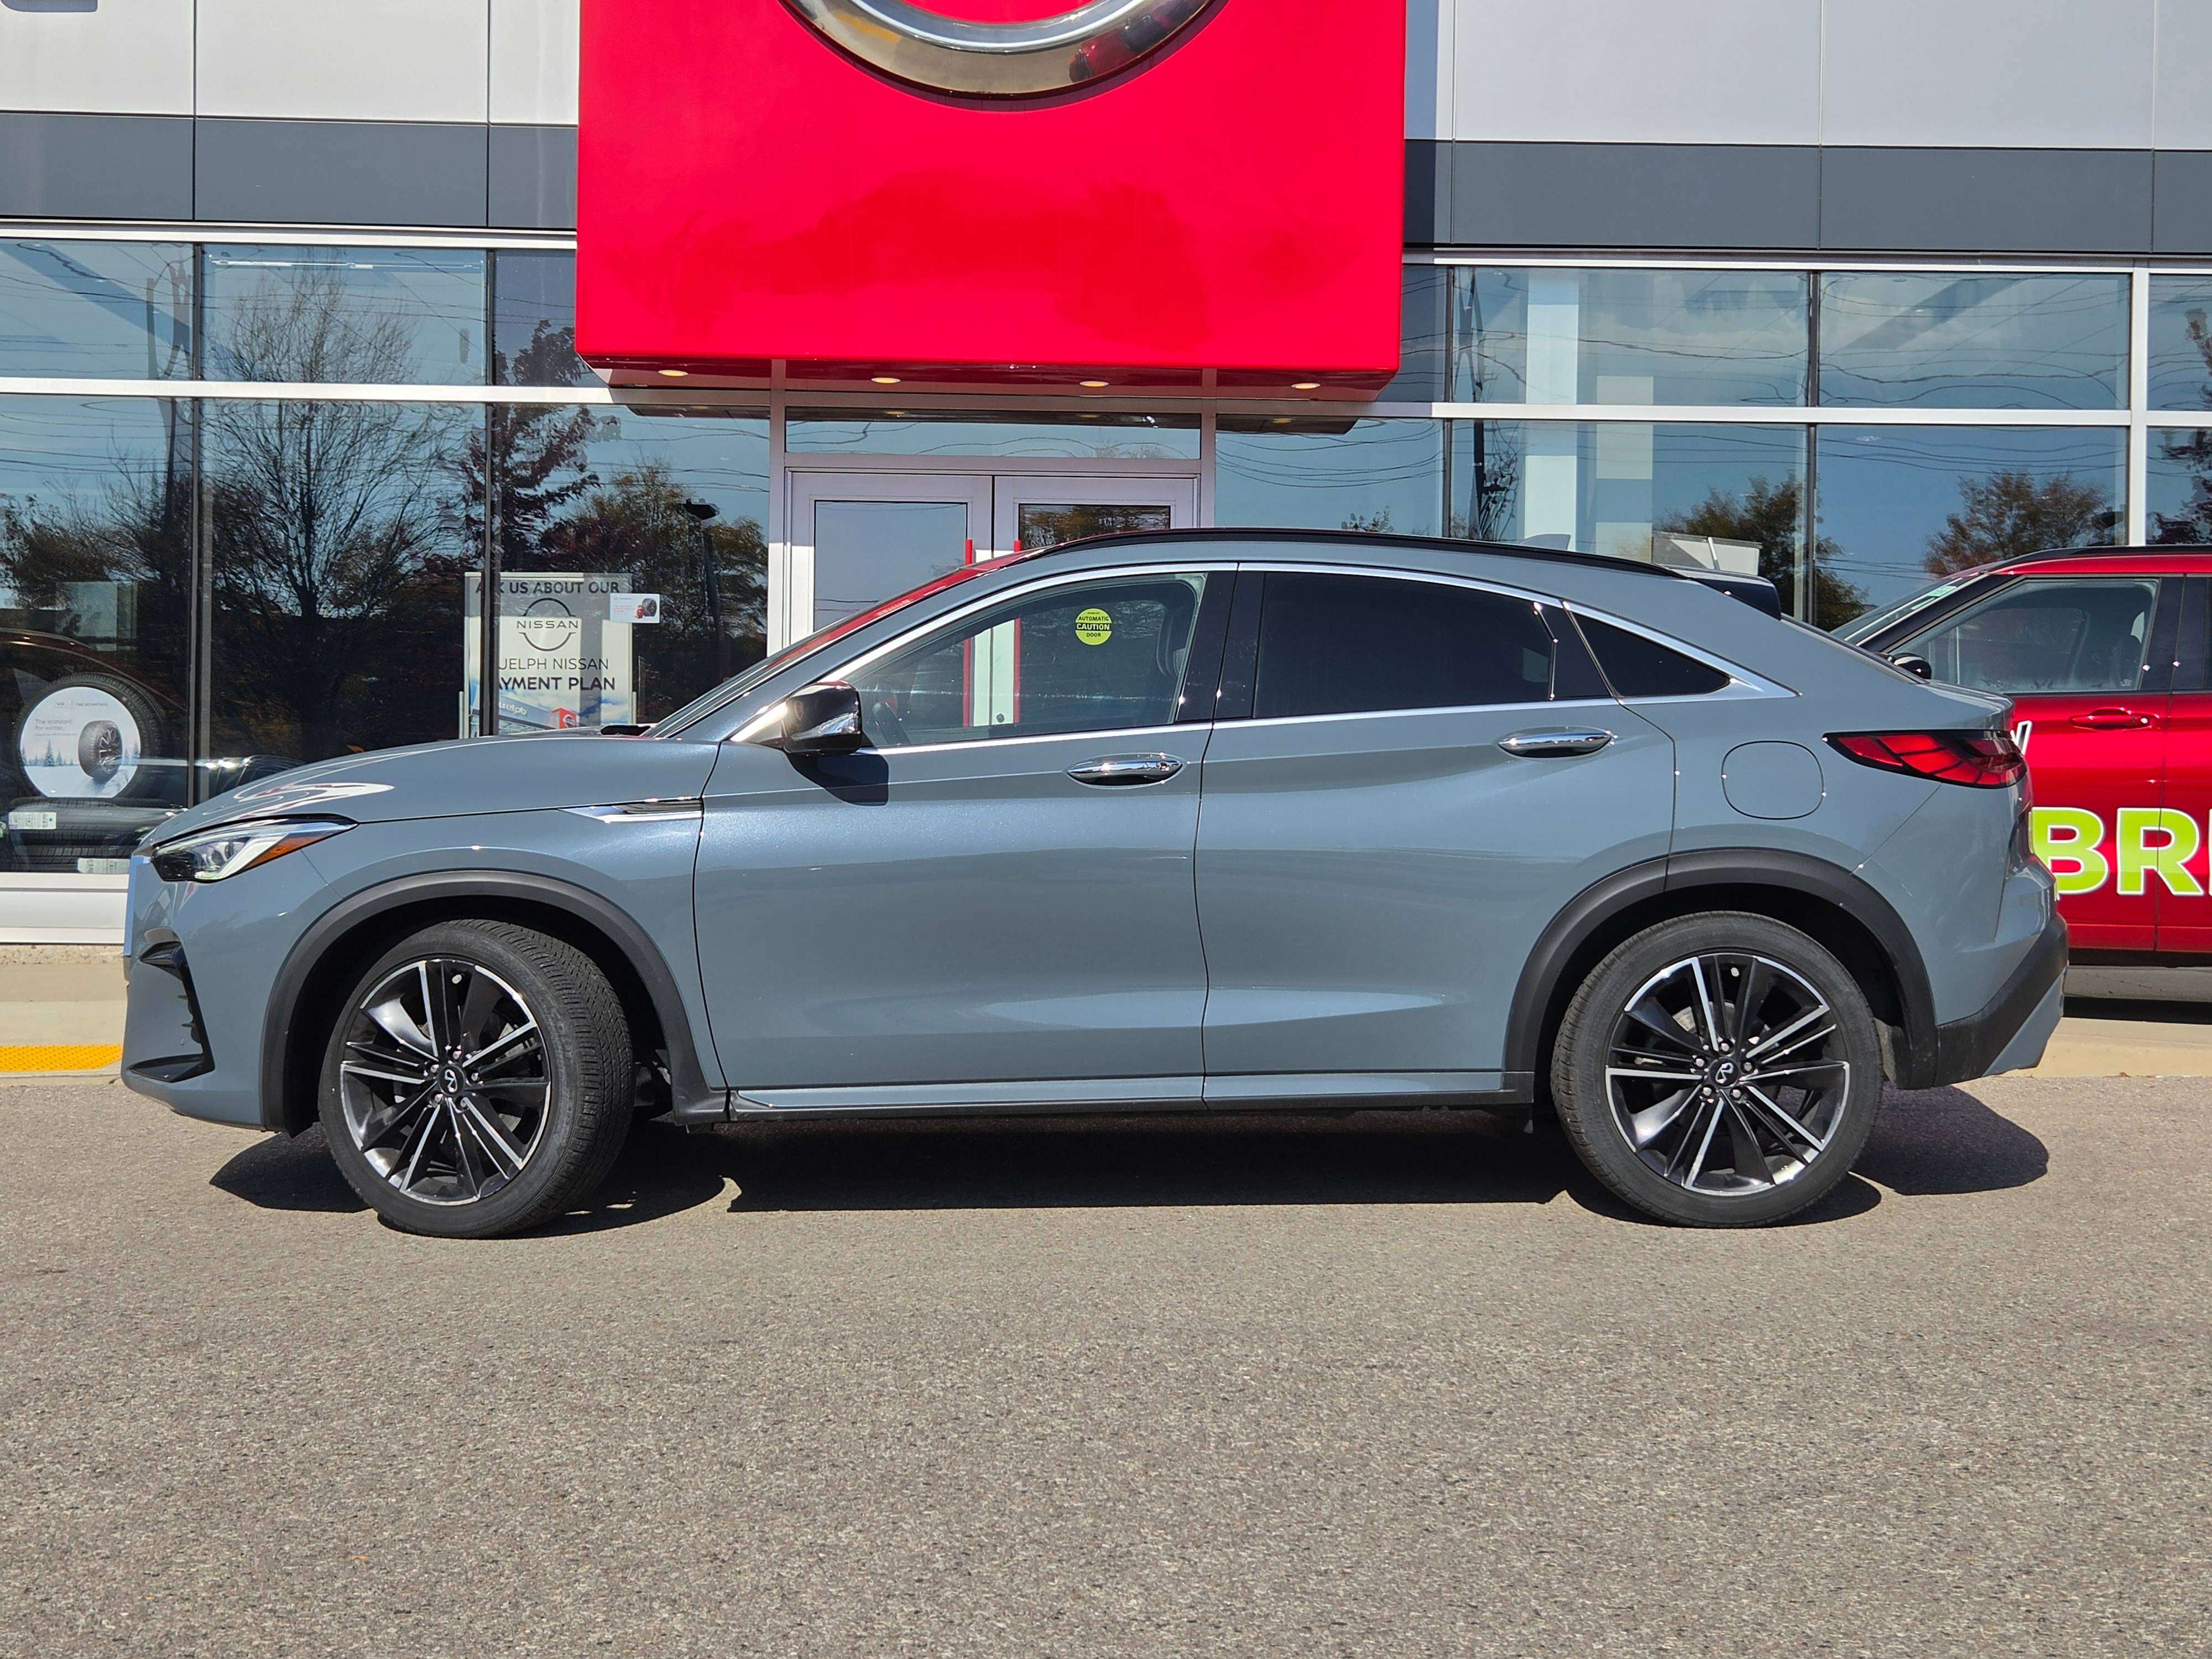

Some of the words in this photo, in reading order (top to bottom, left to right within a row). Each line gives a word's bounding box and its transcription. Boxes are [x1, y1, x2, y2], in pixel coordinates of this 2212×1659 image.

[509, 582, 528, 593] US
[534, 582, 584, 593] ABOUT
[588, 582, 620, 593] OUR
[517, 620, 578, 629] NISSAN
[499, 658, 546, 670] UELPH
[554, 658, 608, 670] NISSAN
[568, 677, 615, 690] PLAN
